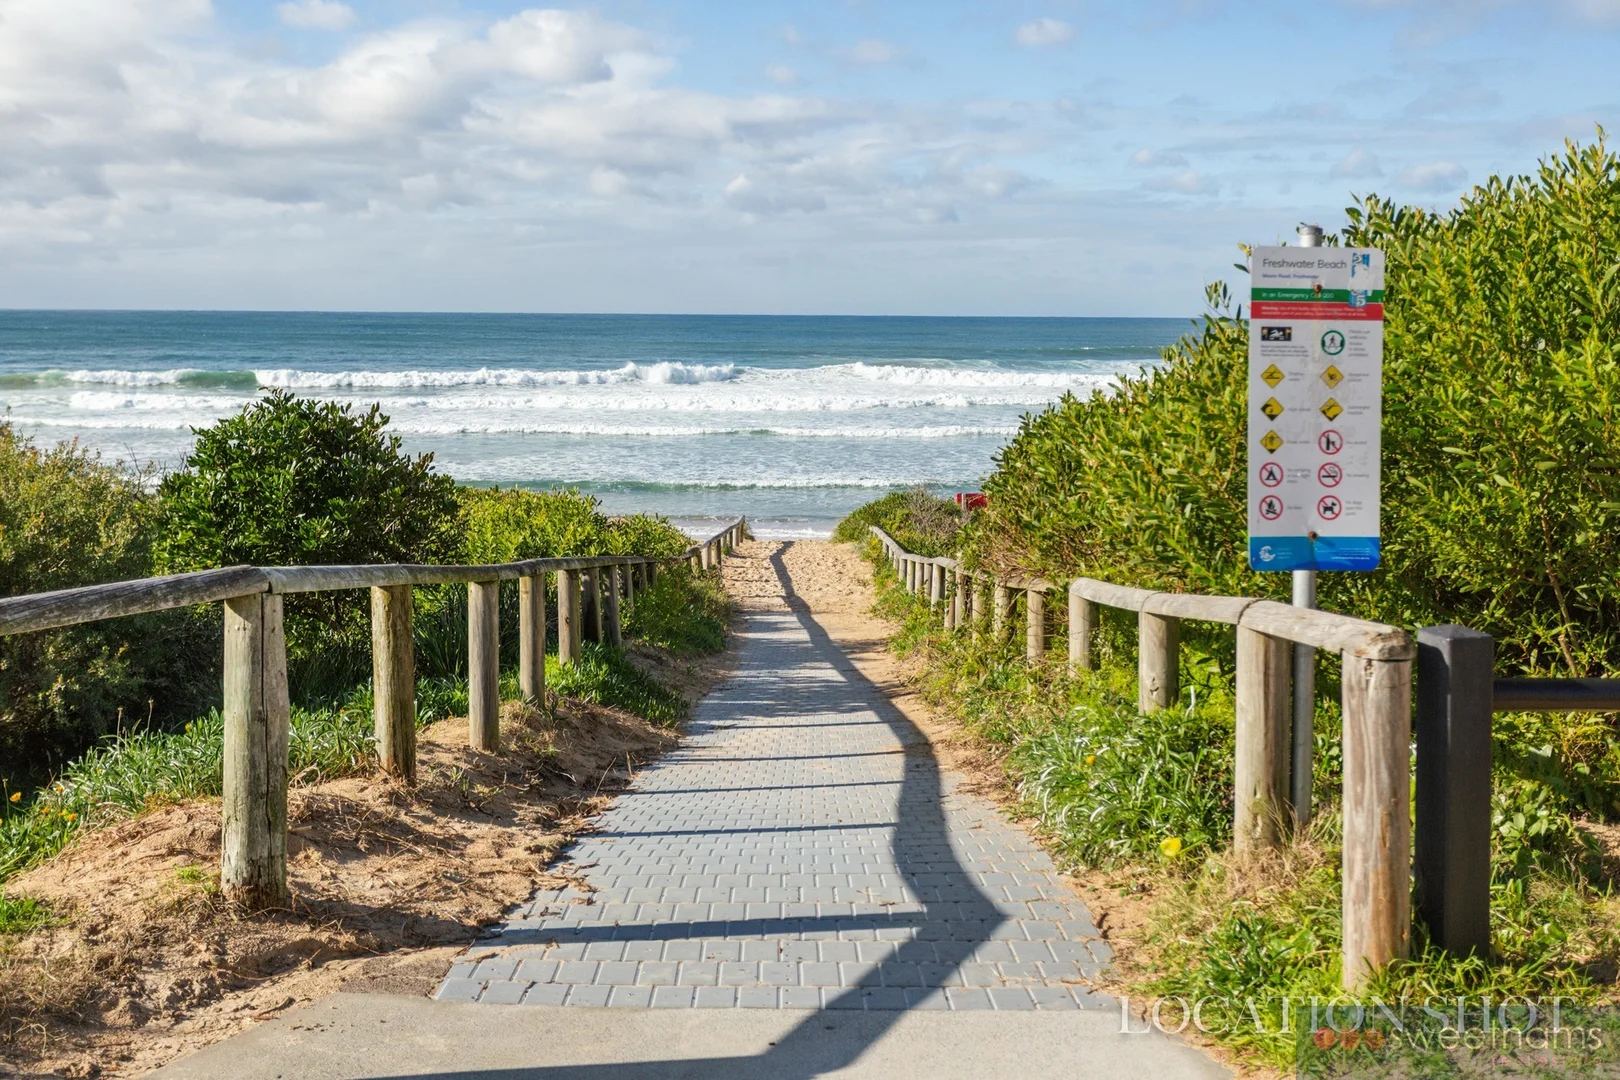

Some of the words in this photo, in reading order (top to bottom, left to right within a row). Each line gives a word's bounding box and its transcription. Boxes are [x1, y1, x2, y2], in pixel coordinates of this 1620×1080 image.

[1262, 258, 1316, 268] Freshwater
[1317, 259, 1347, 269] Beach
[1277, 292, 1309, 300] Emergency
